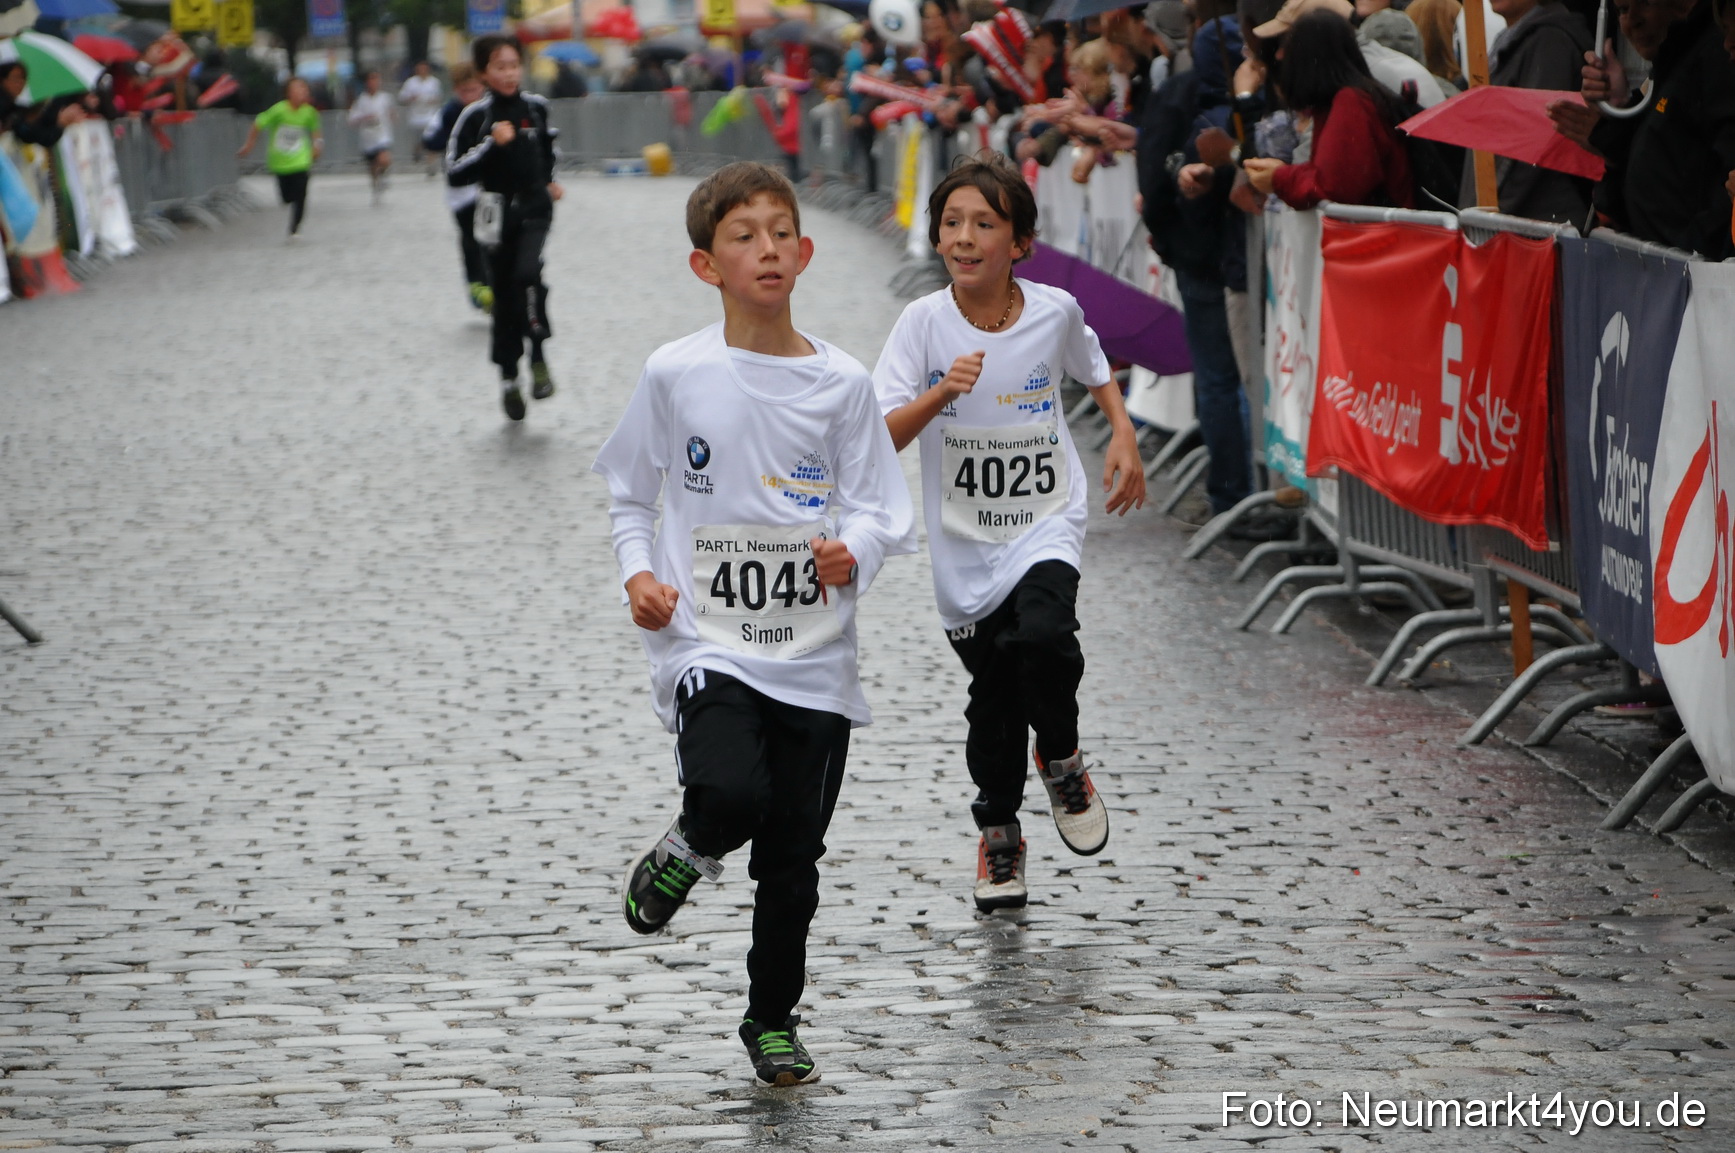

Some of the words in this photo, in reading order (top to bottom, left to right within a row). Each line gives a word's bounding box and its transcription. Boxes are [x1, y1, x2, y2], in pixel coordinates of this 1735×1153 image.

[944, 437, 984, 450] PARTL
[988, 436, 1044, 450] Neumarkt
[684, 470, 713, 486] PARTL
[761, 475, 781, 488] 14.
[954, 451, 1056, 498] 4025
[978, 509, 1033, 527] Marvin
[696, 540, 743, 552] PARTL
[747, 540, 811, 552] Neumark
[710, 557, 821, 611] 4043
[742, 623, 793, 644] Simon
